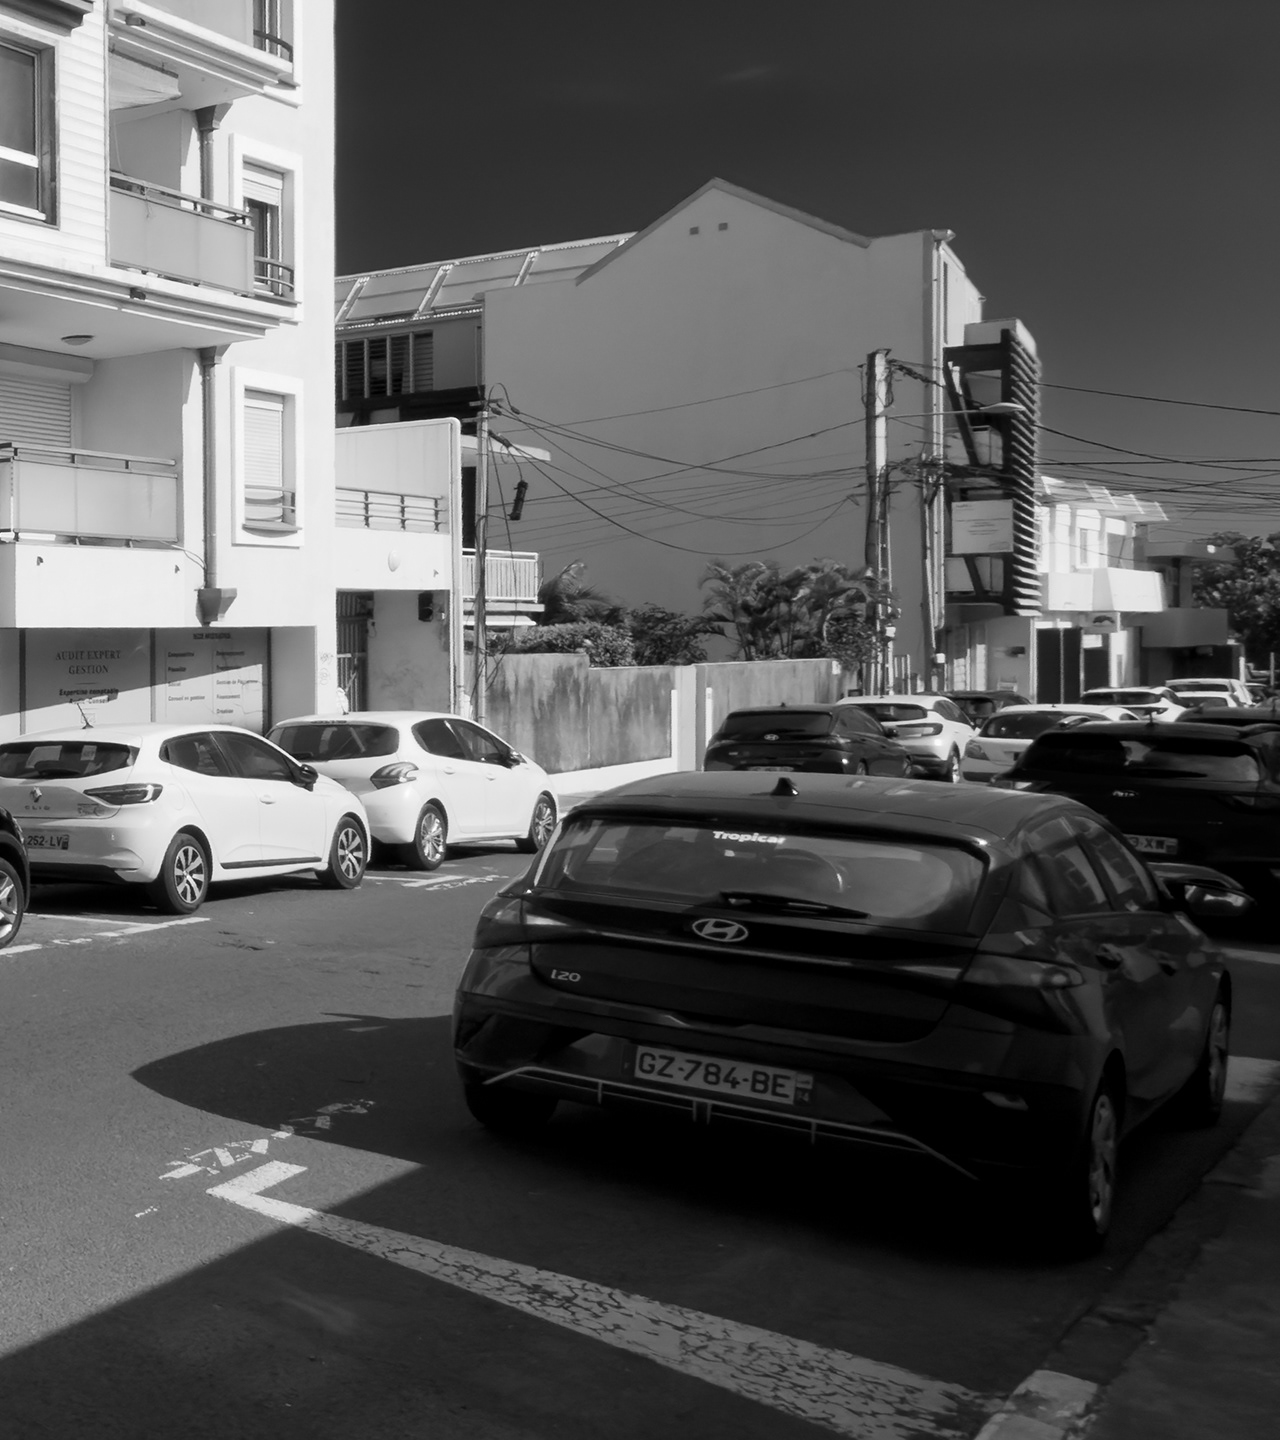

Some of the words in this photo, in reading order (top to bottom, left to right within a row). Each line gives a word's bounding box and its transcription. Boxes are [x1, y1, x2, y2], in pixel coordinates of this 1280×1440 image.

[55, 650, 85, 661] AUDIT
[87, 649, 121, 660] EXPERT
[68, 664, 109, 675] GESTION
[712, 830, 786, 845] Tropicar
[638, 1051, 791, 1099] GZ-784-BE
